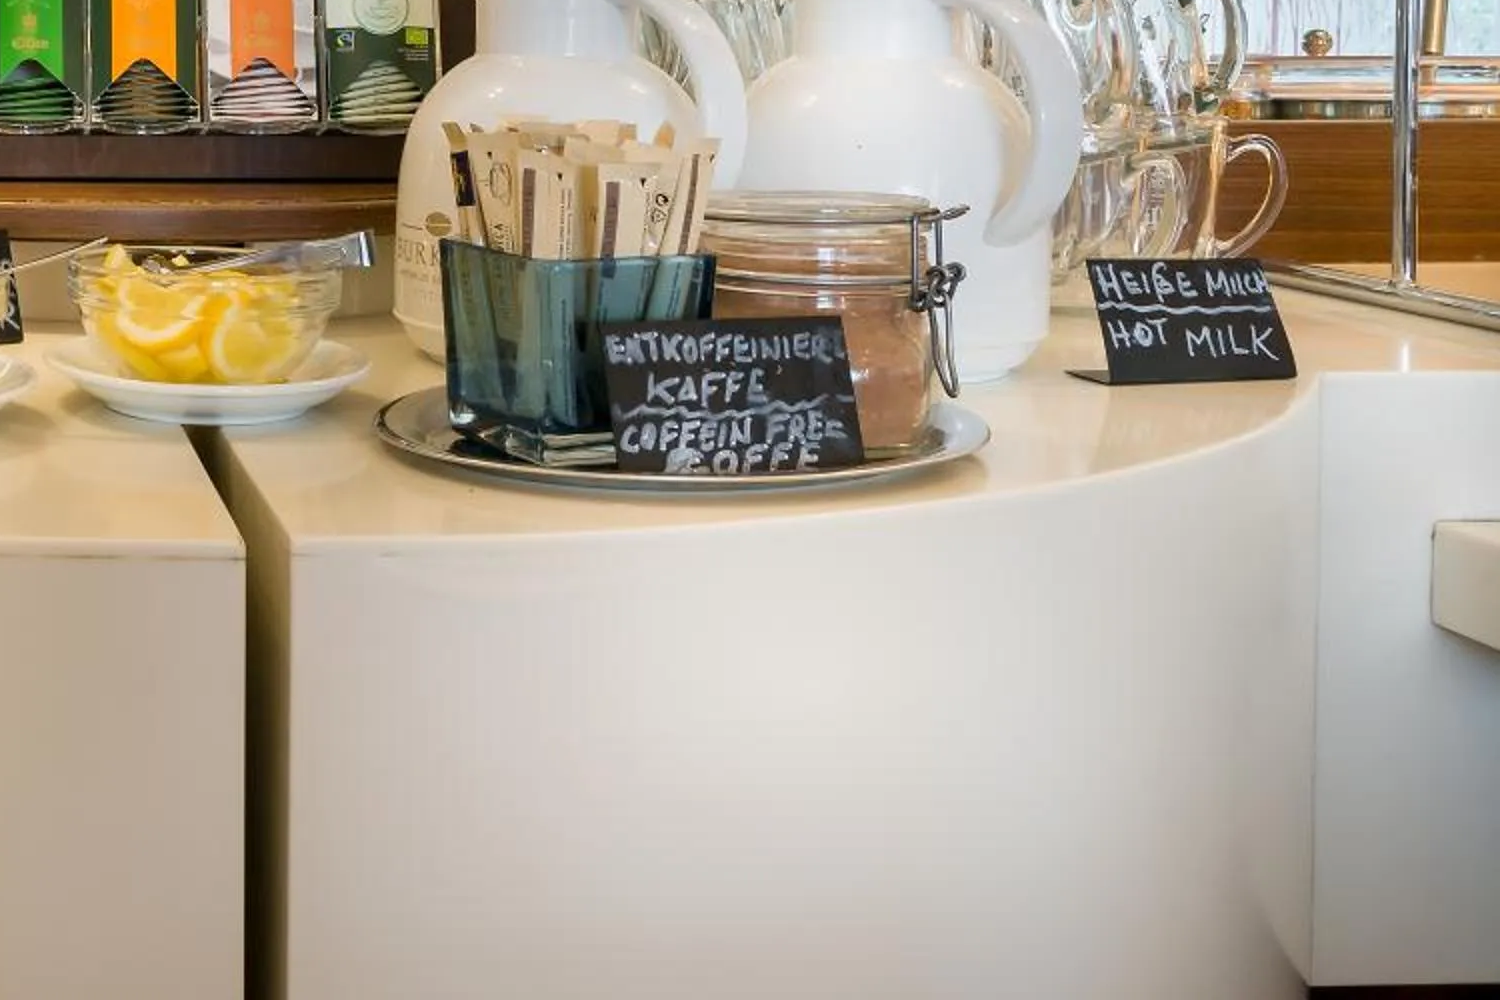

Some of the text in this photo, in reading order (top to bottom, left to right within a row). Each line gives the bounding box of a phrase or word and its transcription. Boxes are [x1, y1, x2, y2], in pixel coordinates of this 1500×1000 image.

[1107, 317, 1280, 360] HOT MILK
[647, 369, 766, 406] KAFFE
[620, 410, 850, 454] COFFEIN FREE
